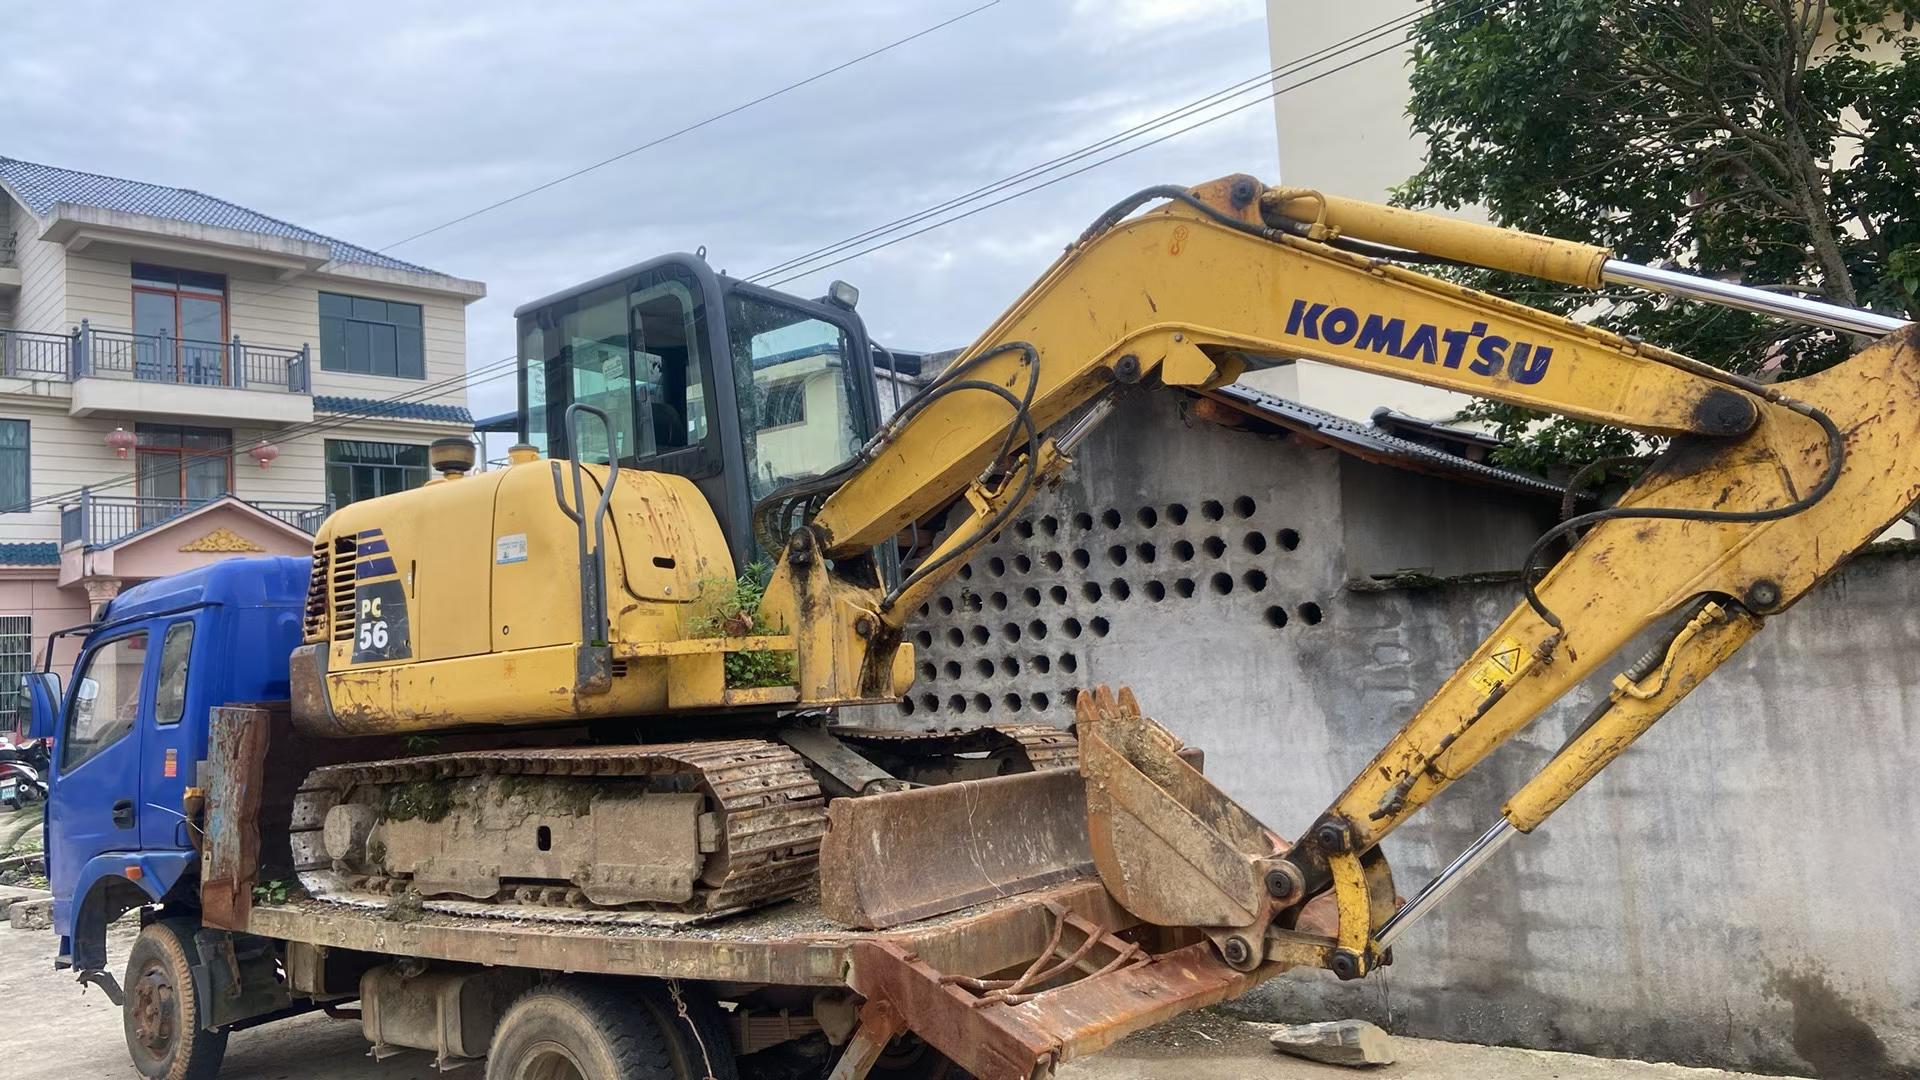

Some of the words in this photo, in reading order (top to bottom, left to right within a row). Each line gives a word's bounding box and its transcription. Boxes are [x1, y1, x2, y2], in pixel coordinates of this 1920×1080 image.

[1284, 299, 1554, 385] KOMATSU
[361, 597, 382, 619] PC
[360, 620, 388, 650] 56
